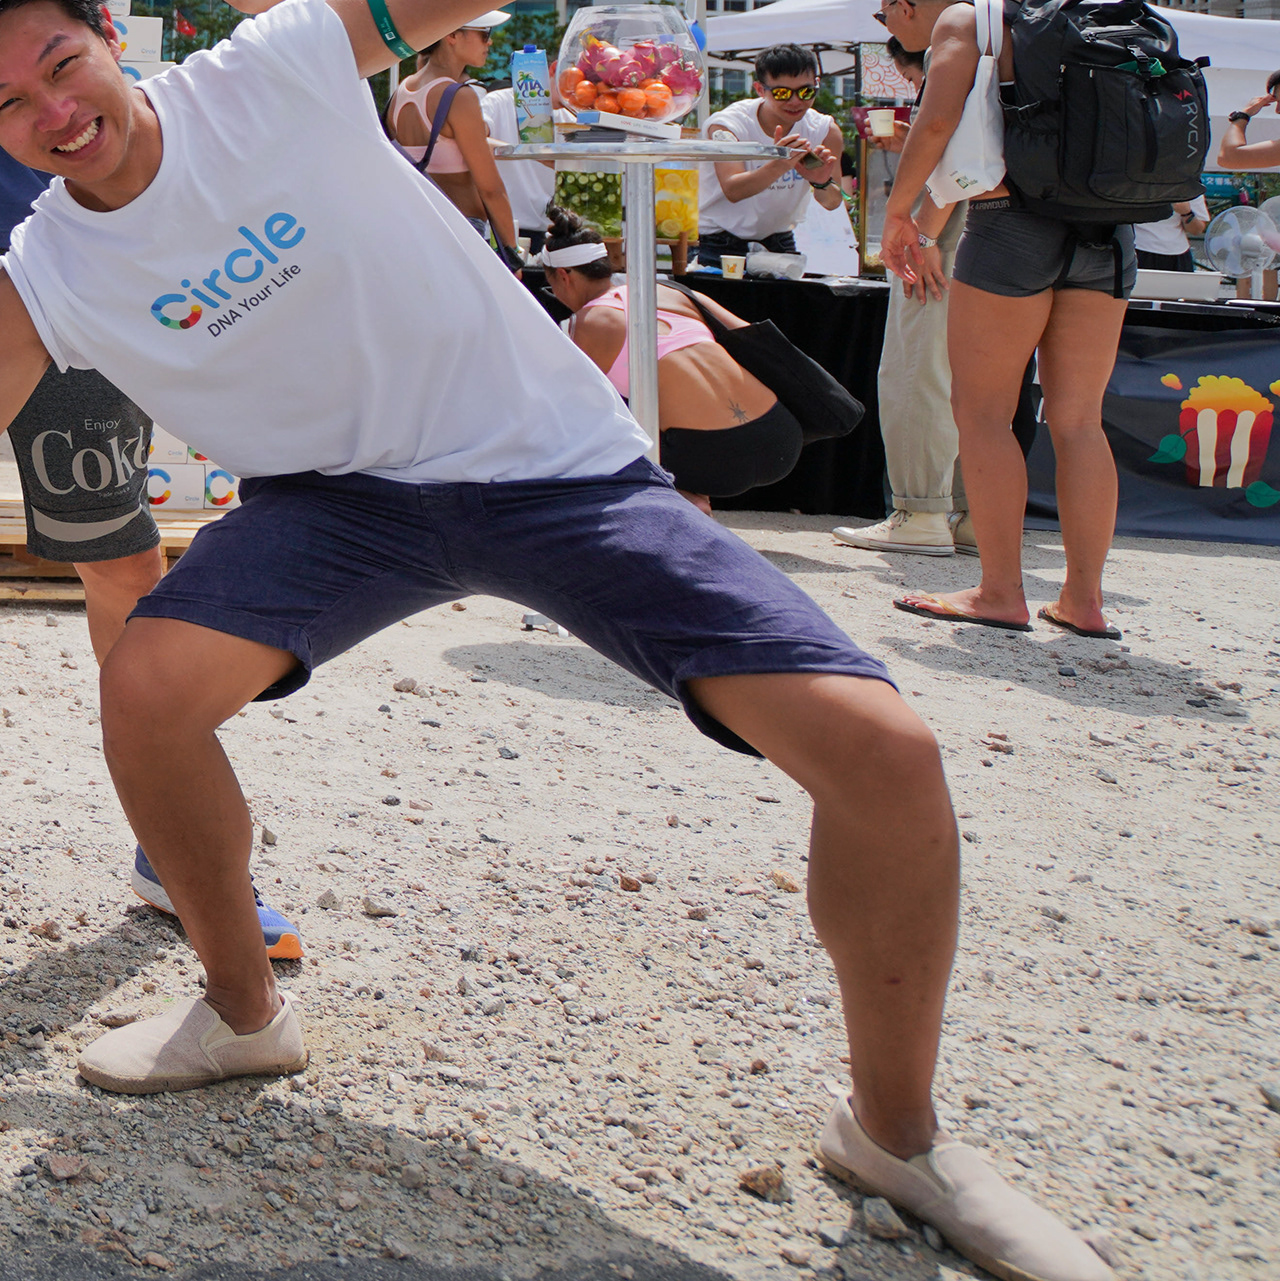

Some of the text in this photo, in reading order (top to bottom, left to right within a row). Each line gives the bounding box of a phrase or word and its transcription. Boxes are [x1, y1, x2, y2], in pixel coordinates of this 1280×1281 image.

[516, 81, 545, 92] VITA
[1182, 101, 1198, 158] RVCA
[151, 212, 306, 330] Circle
[207, 264, 301, 338] DNA Your Life
[85, 418, 122, 433] Enjoy
